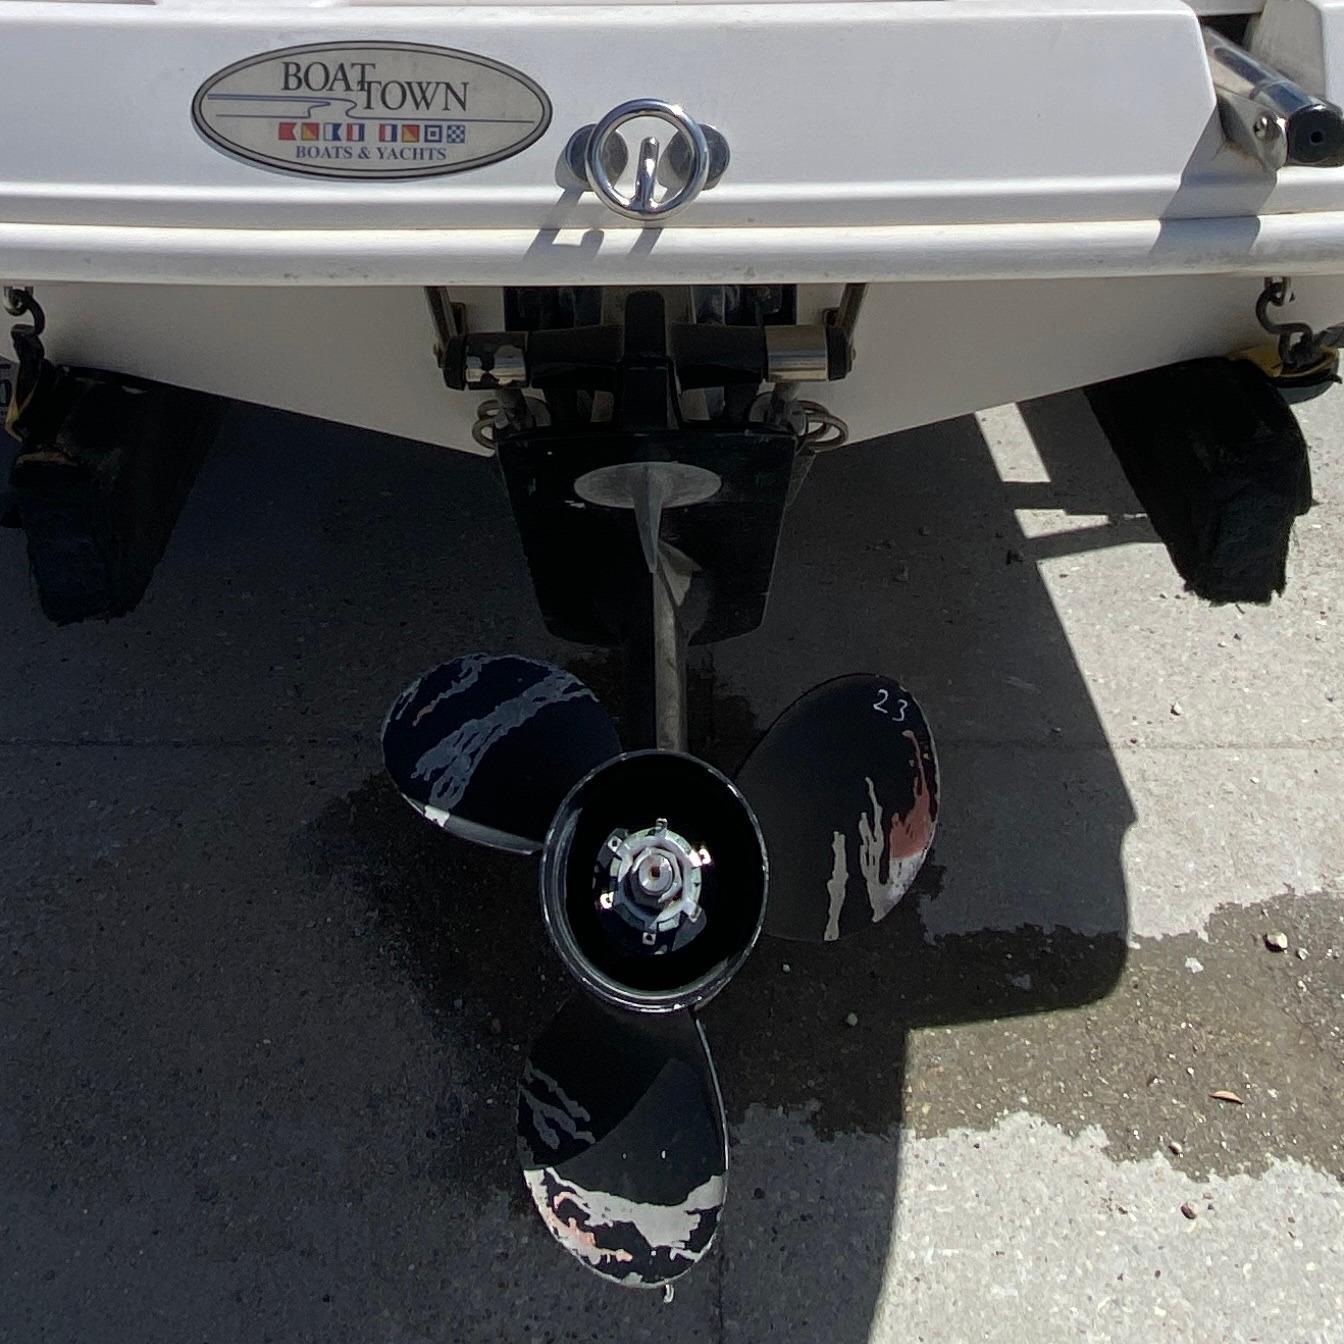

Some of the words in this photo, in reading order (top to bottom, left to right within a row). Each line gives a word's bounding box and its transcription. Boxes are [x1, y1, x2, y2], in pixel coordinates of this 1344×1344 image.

[281, 61, 376, 92] BOAT
[357, 80, 470, 111] TOWN
[296, 145, 353, 160] BOATS
[358, 146, 371, 160] &
[376, 147, 447, 161] YACHTS
[873, 689, 908, 721] 23
